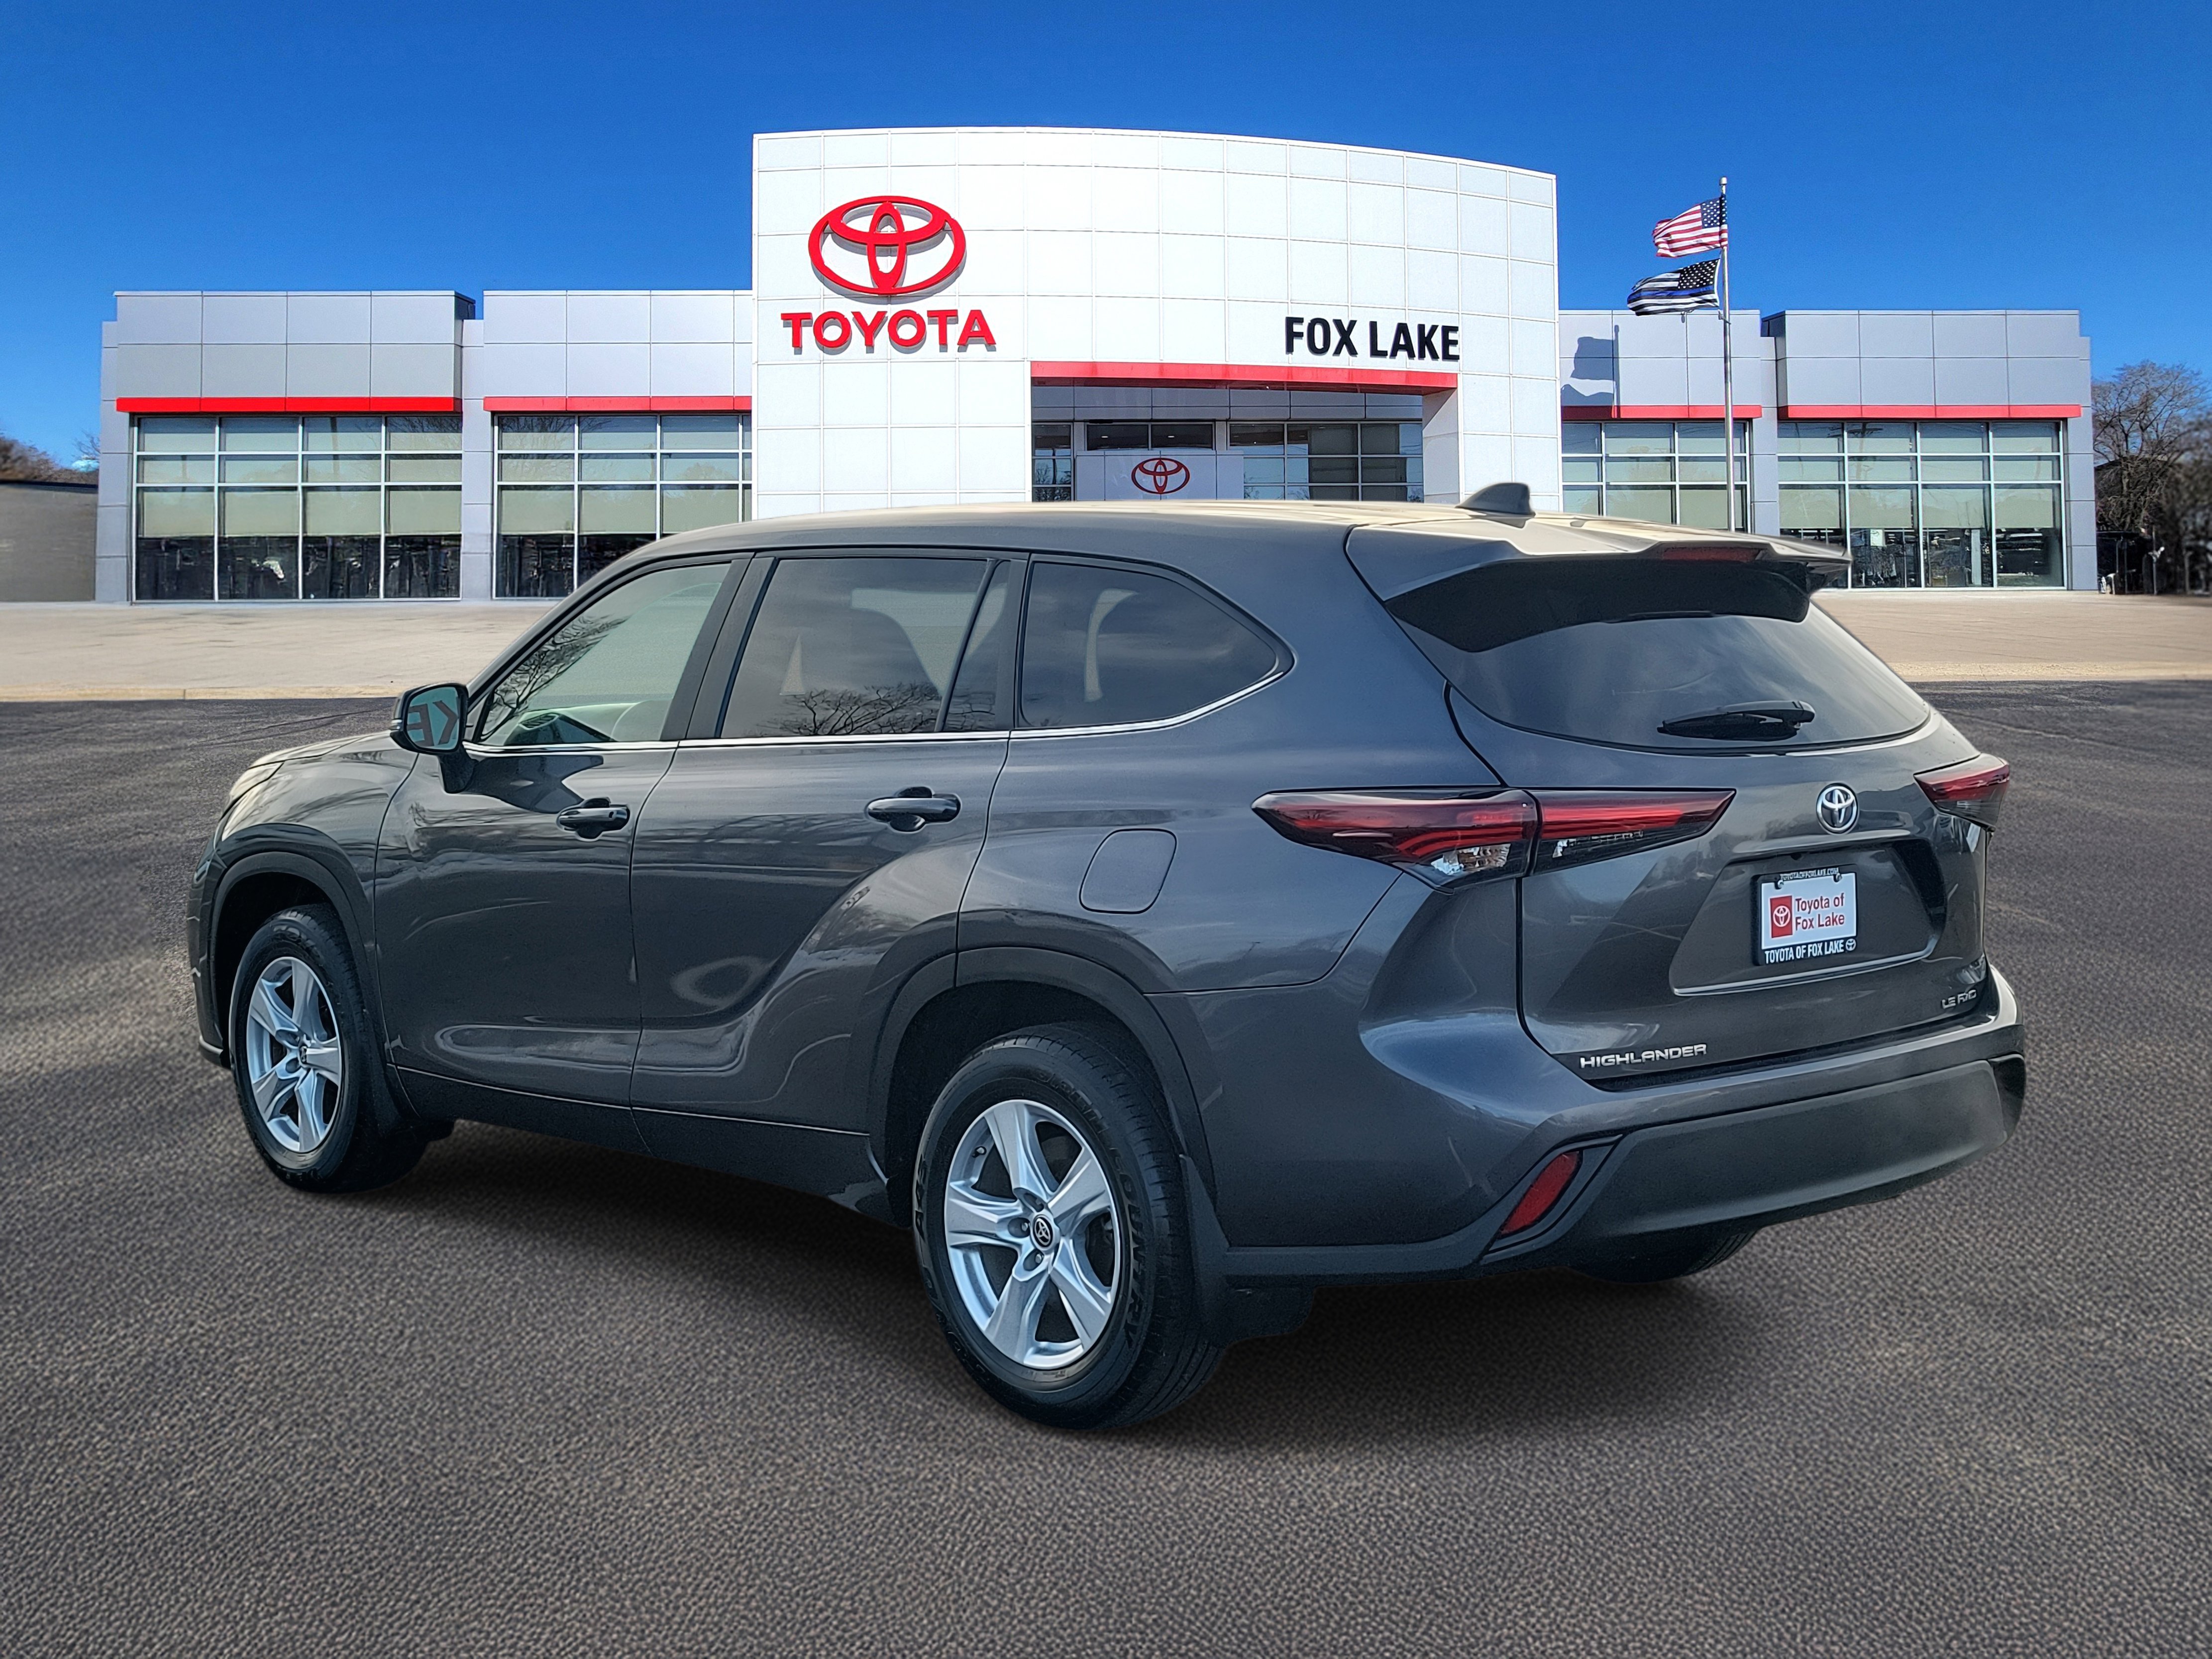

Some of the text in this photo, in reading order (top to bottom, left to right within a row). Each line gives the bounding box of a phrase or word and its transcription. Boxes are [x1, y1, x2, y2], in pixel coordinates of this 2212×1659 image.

[781, 309, 997, 348] TOYOTA
[1285, 316, 1460, 361] FOX LAKE
[1795, 892, 1845, 915] Toyota of
[1795, 912, 1845, 931] Fox Lake
[1764, 939, 1845, 964] TOYOTA OF FOX LAKE
[1941, 996, 1957, 1009] LE
[1580, 1043, 1707, 1068] HIGHLANDER
